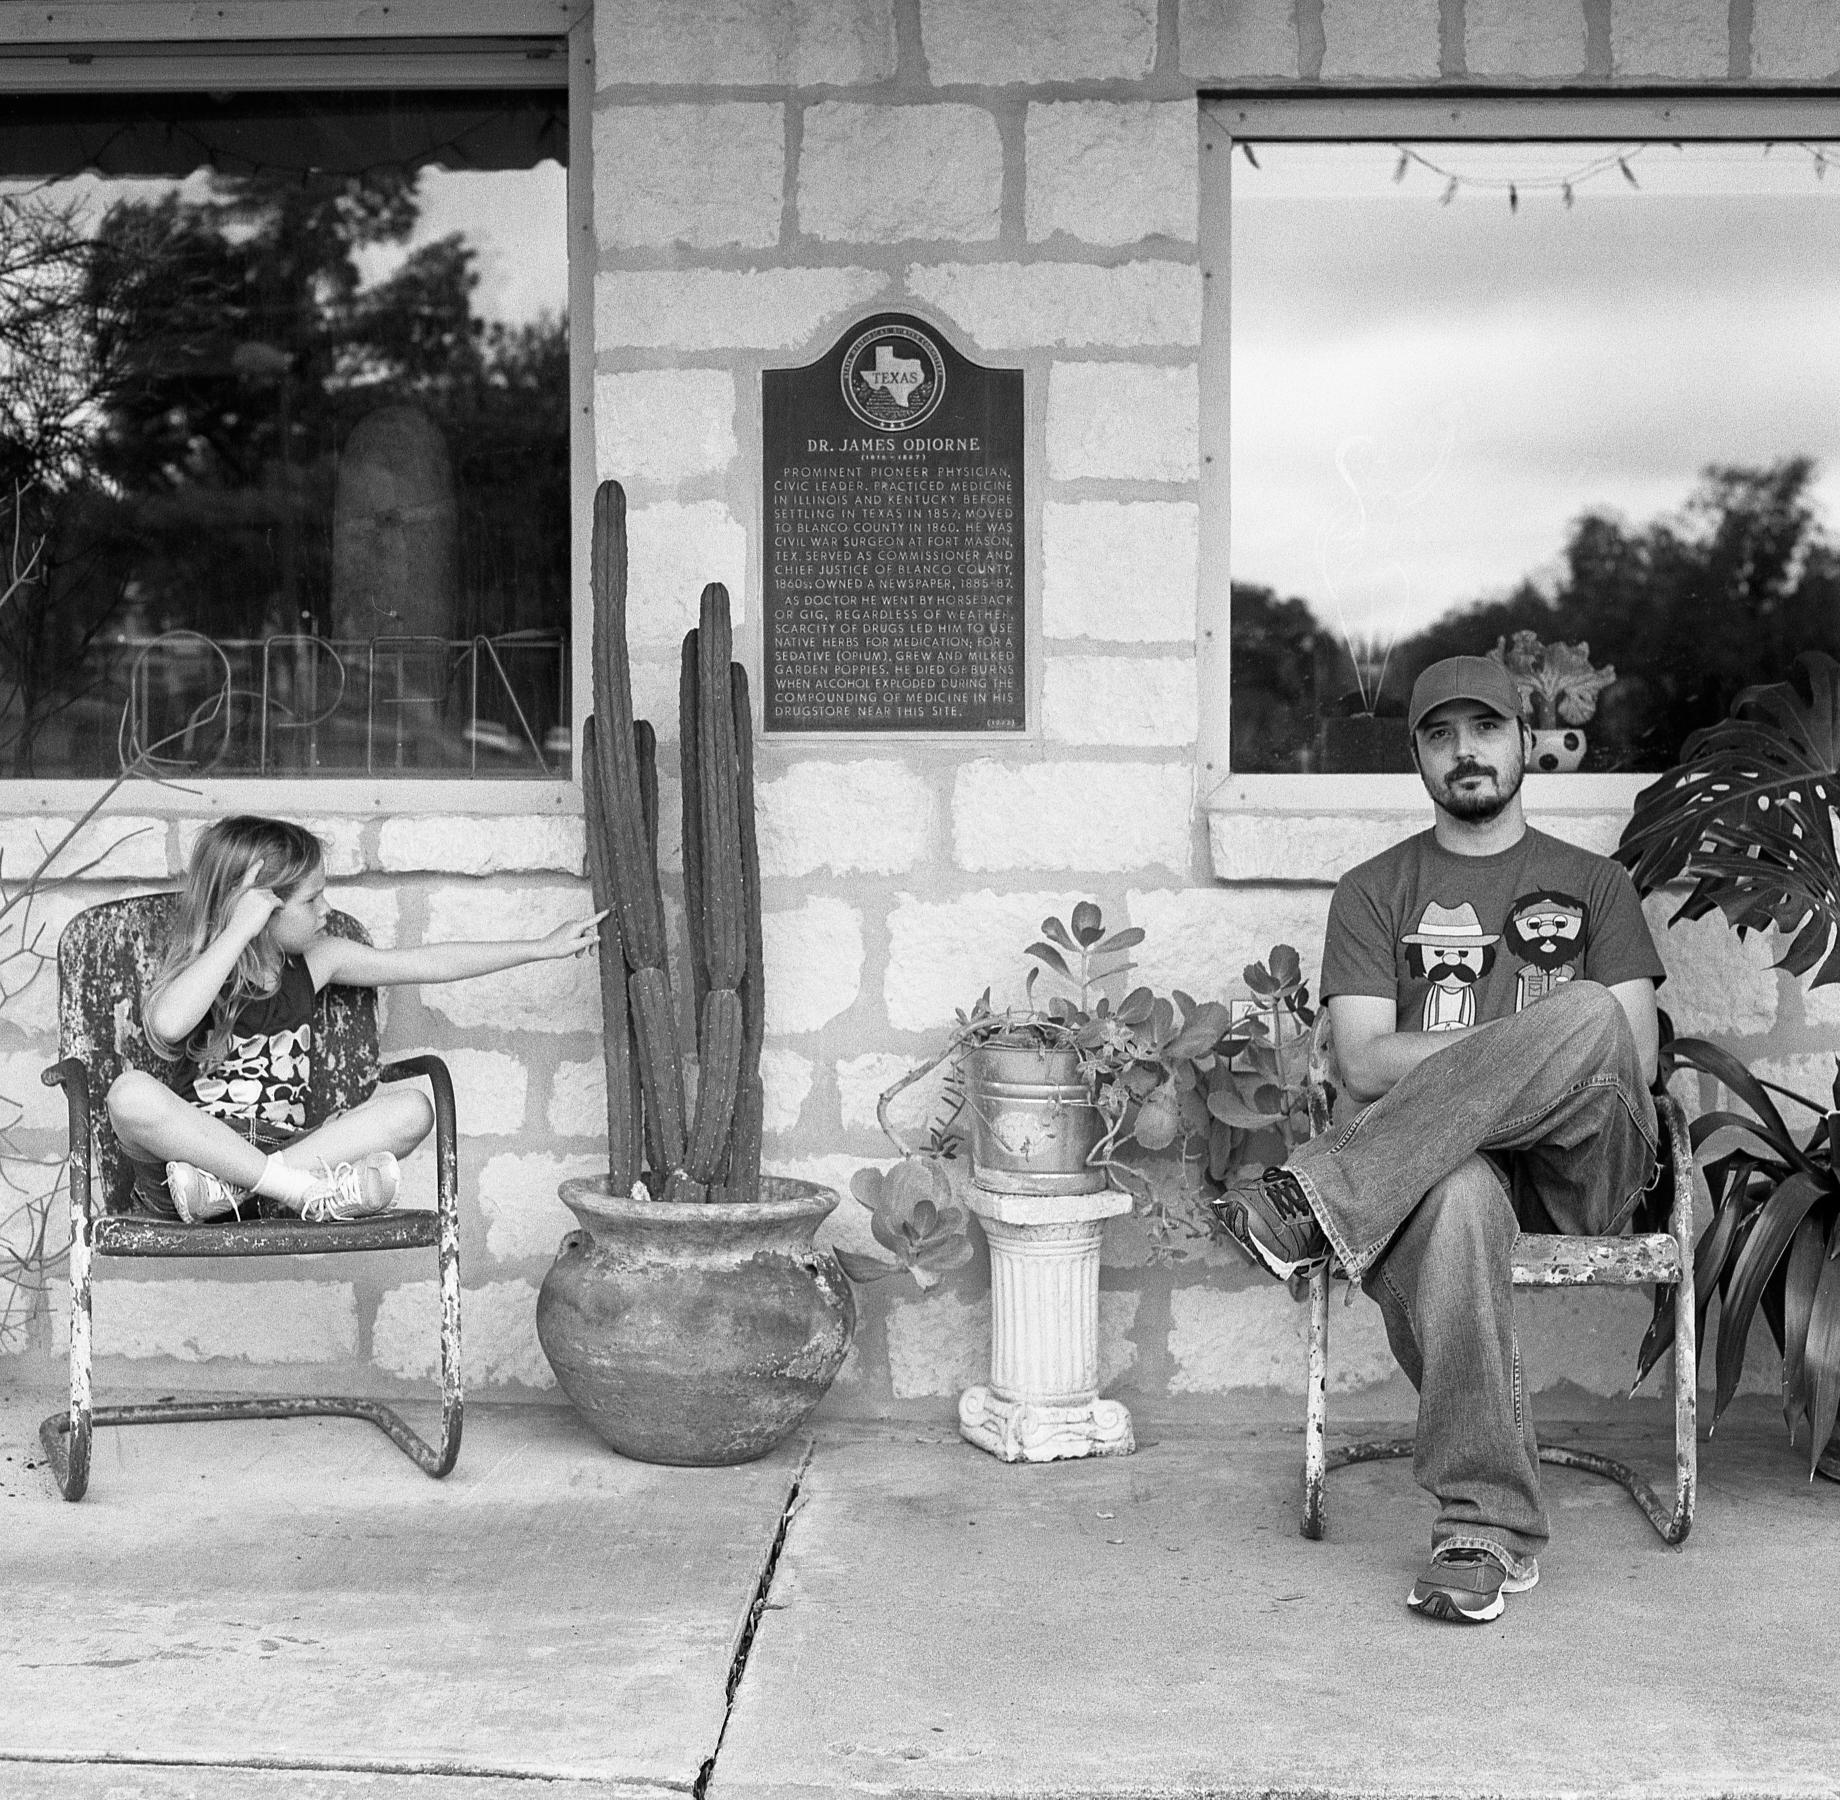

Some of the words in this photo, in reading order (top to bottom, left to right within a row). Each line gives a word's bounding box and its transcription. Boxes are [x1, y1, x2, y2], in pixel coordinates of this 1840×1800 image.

[873, 372, 918, 384] TEXAS
[807, 439, 834, 452] DR.
[839, 439, 896, 452] JAMES
[903, 438, 980, 452] ODIORNE
[784, 467, 862, 478] PROMINENT
[871, 467, 929, 478] PIONEER
[774, 481, 809, 492] CIVIC
[815, 481, 868, 492] LEADER.
[874, 481, 944, 492] PRACTICED
[950, 481, 1012, 492] MEDICINE
[774, 494, 787, 505] IN
[794, 494, 848, 505] ILLINOIS
[854, 494, 881, 505] AND
[889, 494, 955, 505] KENTUCKY
[963, 494, 1012, 505] BEFORE
[774, 509, 835, 519] SETTLING
[841, 509, 855, 519] IN
[863, 509, 902, 519] TEXAS
[908, 509, 922, 519] IN
[965, 509, 1013, 519] MOVED
[775, 522, 792, 533] TO
[798, 522, 848, 533] BLANCO
[853, 522, 905, 533] COUNTY
[909, 522, 922, 533] IN
[927, 522, 959, 533] 1860.
[965, 522, 981, 533] HE
[987, 522, 1013, 533] WAS
[775, 536, 806, 547] CIVIL
[810, 536, 838, 547] WAR
[843, 536, 904, 547] SURGEON
[909, 536, 922, 547] AT
[928, 536, 958, 547] FORT
[806, 551, 852, 561] SERVED
[857, 551, 872, 561] AS
[878, 551, 979, 561] COMMISSIONER
[986, 551, 1013, 561] AND
[775, 564, 813, 575] CHIEF
[819, 564, 869, 575] JUSTICE
[875, 564, 893, 575] OF
[898, 564, 952, 575] BLANCO
[815, 579, 862, 590] OWNED
[867, 579, 875, 590] A
[785, 595, 799, 606] AS
[804, 595, 857, 606] DOCTOR
[861, 595, 876, 606] HE
[881, 595, 915, 606] WENT
[920, 595, 933, 606] BY
[937, 595, 1013, 606] HORSEBACK
[774, 610, 793, 620] OR
[836, 610, 917, 620] REGARDLESS
[923, 610, 941, 620] OF
[775, 623, 835, 634] SCARCITY
[840, 623, 857, 634] OF
[863, 623, 904, 634] DRUGS
[910, 623, 933, 634] LED
[938, 623, 962, 634] HIM
[967, 623, 984, 634] TO
[990, 623, 1013, 634] USE
[775, 637, 815, 648] NATIVE
[823, 637, 859, 648] HERBS
[866, 637, 889, 648] FOR
[977, 637, 1001, 648] FOR
[1005, 637, 1013, 648] A
[775, 651, 831, 662] SEDATIVE
[896, 651, 932, 662] GREW
[937, 651, 963, 662] AND
[968, 651, 1014, 662] MILKED
[775, 665, 828, 676] GARDEN
[835, 665, 889, 676] POPPIES.
[895, 665, 911, 676] HE
[916, 665, 945, 676] DIED
[950, 665, 967, 676] OF
[971, 665, 1014, 676] BURNS
[776, 679, 810, 689] WHEN
[815, 679, 871, 689] ALCOHOL
[875, 679, 935, 689] EXPLODED
[941, 679, 987, 689] DURING
[993, 679, 1013, 689] THE
[132, 629, 566, 776] OPEN
[775, 693, 877, 703] COMPOUNDING
[883, 693, 901, 703] OF
[906, 693, 968, 703] MEDICINE
[974, 693, 986, 703] IN
[993, 693, 1013, 703] HIS
[775, 706, 850, 717] DRUGSTORE
[858, 706, 890, 717] NEAR
[897, 706, 924, 717] THIS
[932, 706, 963, 717] SITE.
